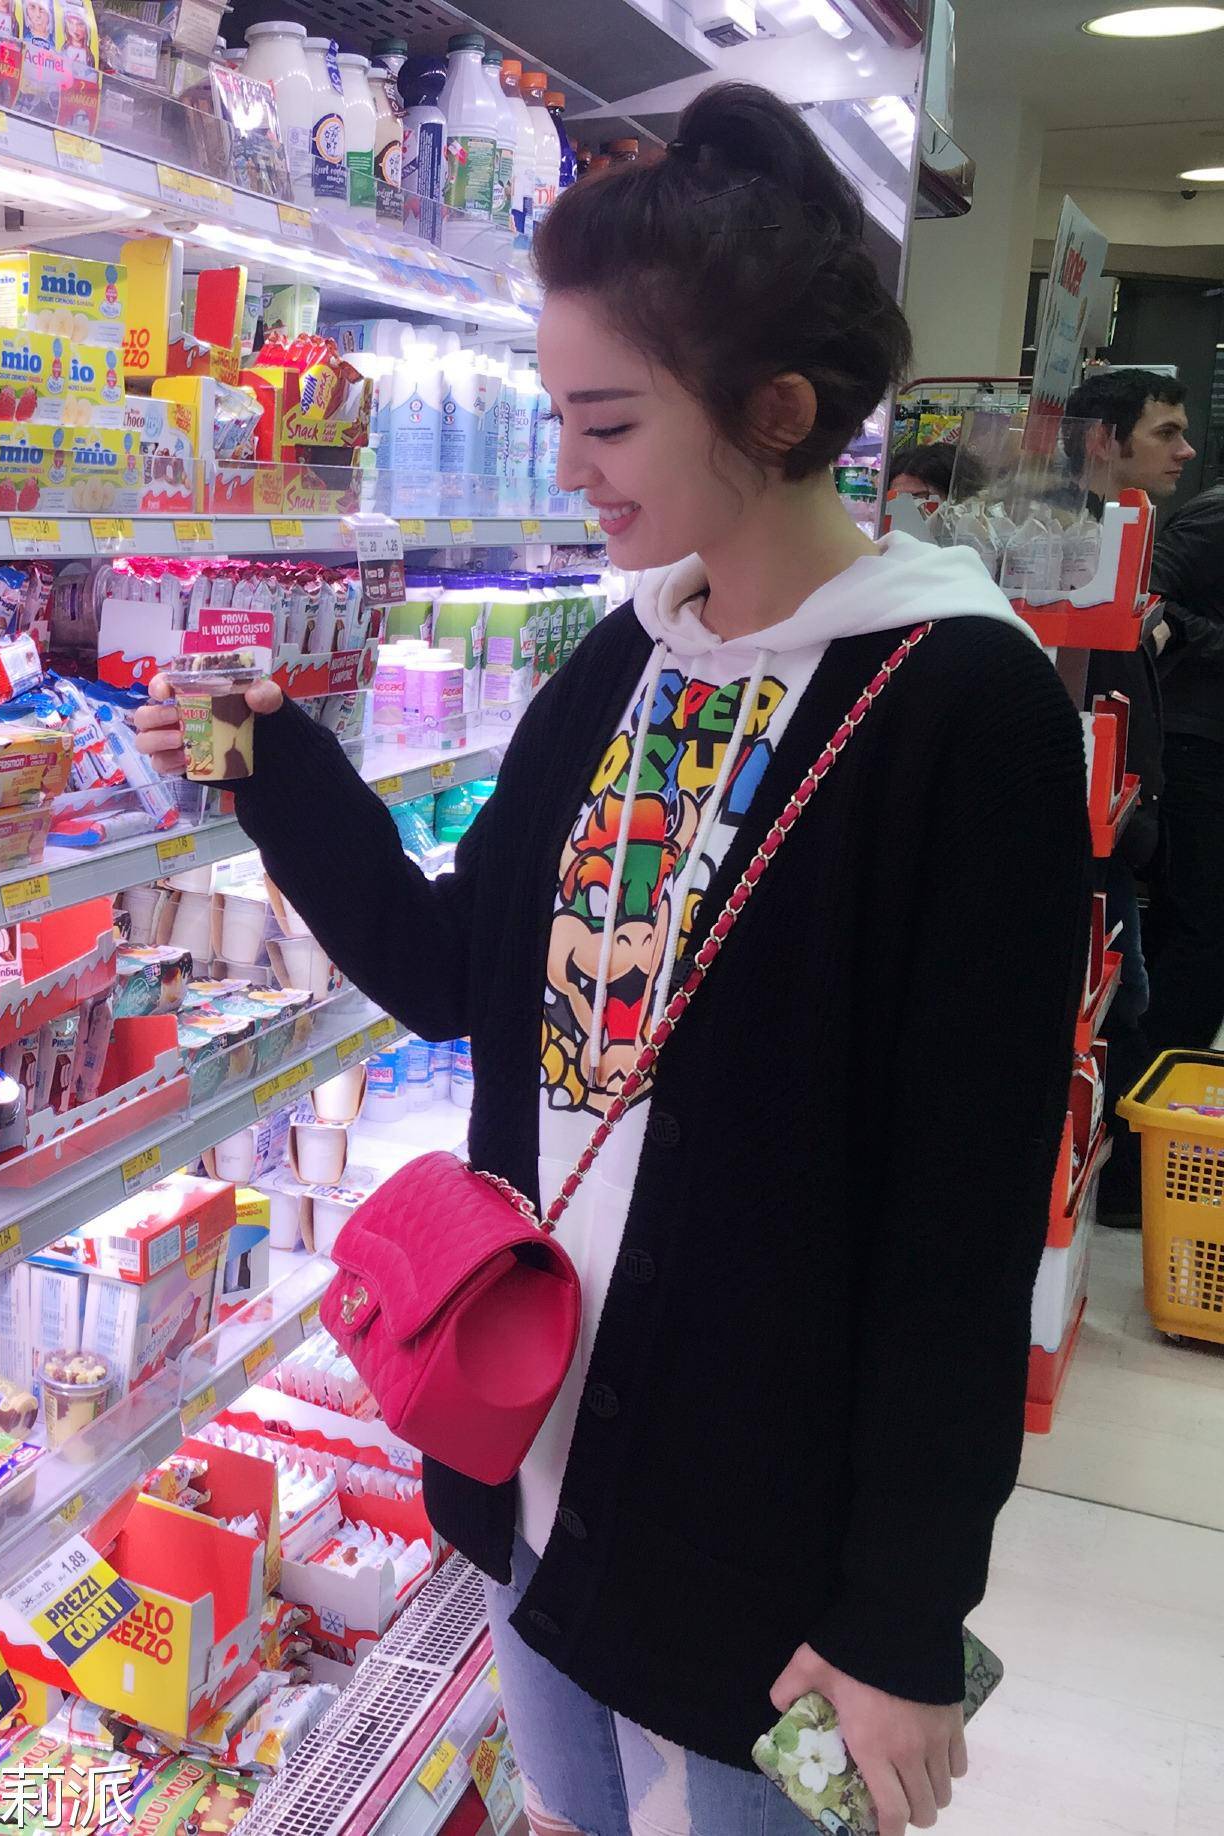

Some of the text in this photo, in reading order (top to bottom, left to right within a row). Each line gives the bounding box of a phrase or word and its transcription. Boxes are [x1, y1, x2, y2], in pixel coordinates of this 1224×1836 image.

[25, 50, 64, 73] Actimel
[41, 269, 92, 297] mio
[1, 346, 42, 372] mio
[286, 412, 320, 441] Snack
[0, 439, 43, 465] mio
[73, 442, 117, 467] mio
[202, 623, 270, 636] IL NUOVO GUSTO
[221, 613, 250, 624] PROVA
[216, 634, 257, 646] LAMPONE
[62, 1550, 88, 1576] 1,89
[45, 1574, 102, 1629] PREZZI
[63, 1592, 123, 1652] CORTI
[130, 1602, 173, 1636] LIO
[106, 1624, 173, 1666] REZZO
